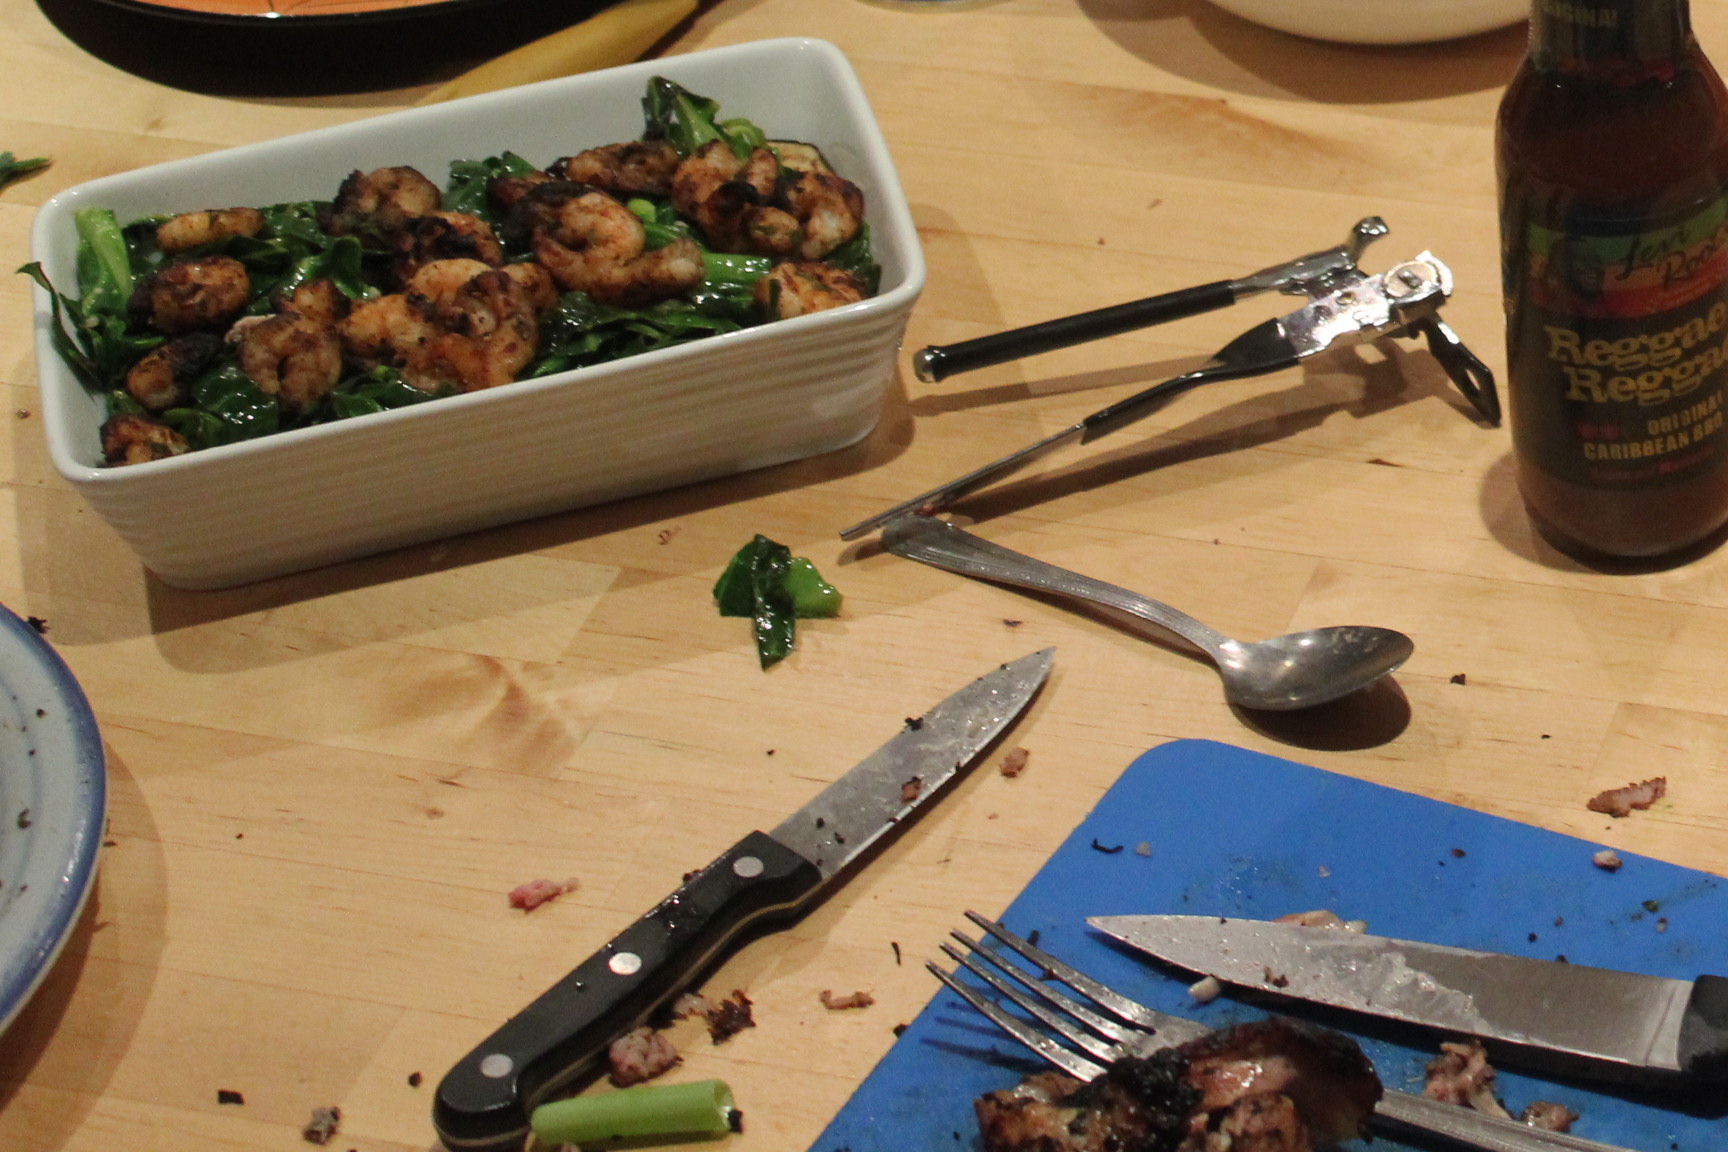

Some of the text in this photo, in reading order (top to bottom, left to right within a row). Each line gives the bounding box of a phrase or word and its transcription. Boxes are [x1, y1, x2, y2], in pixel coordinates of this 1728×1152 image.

[1545, 301, 1727, 371] Reggae
[1583, 431, 1691, 460] CARIBBEAN
[1692, 411, 1724, 442] BBQ
